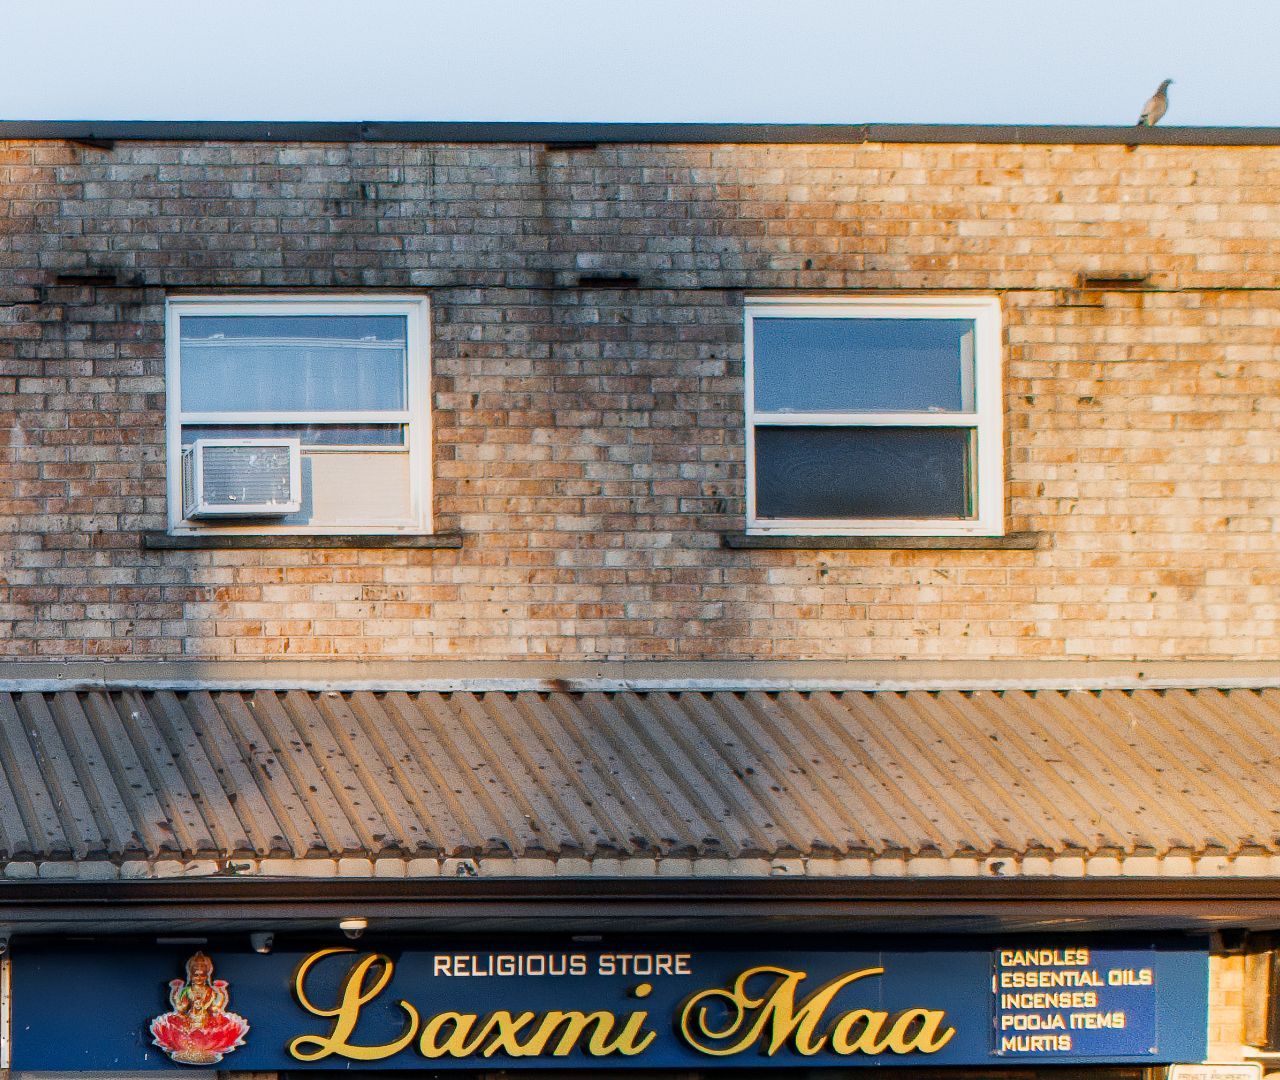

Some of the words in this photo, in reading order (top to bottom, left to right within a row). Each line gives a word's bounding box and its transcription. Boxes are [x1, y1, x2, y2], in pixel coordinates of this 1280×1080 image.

[435, 954, 587, 976] RELIGIOUS
[597, 953, 692, 976] STORE
[1001, 949, 1089, 966] CANDLES
[1001, 969, 1104, 987] ESSENTIAL
[1108, 968, 1153, 986] OILS
[289, 948, 658, 1061] Laxmi
[679, 965, 956, 1057] Maa
[1001, 991, 1098, 1009] INCENSES
[1001, 1013, 1065, 1031] POOJA
[1069, 1012, 1126, 1030] ITEMS
[1001, 1034, 1072, 1052] MURTIS
